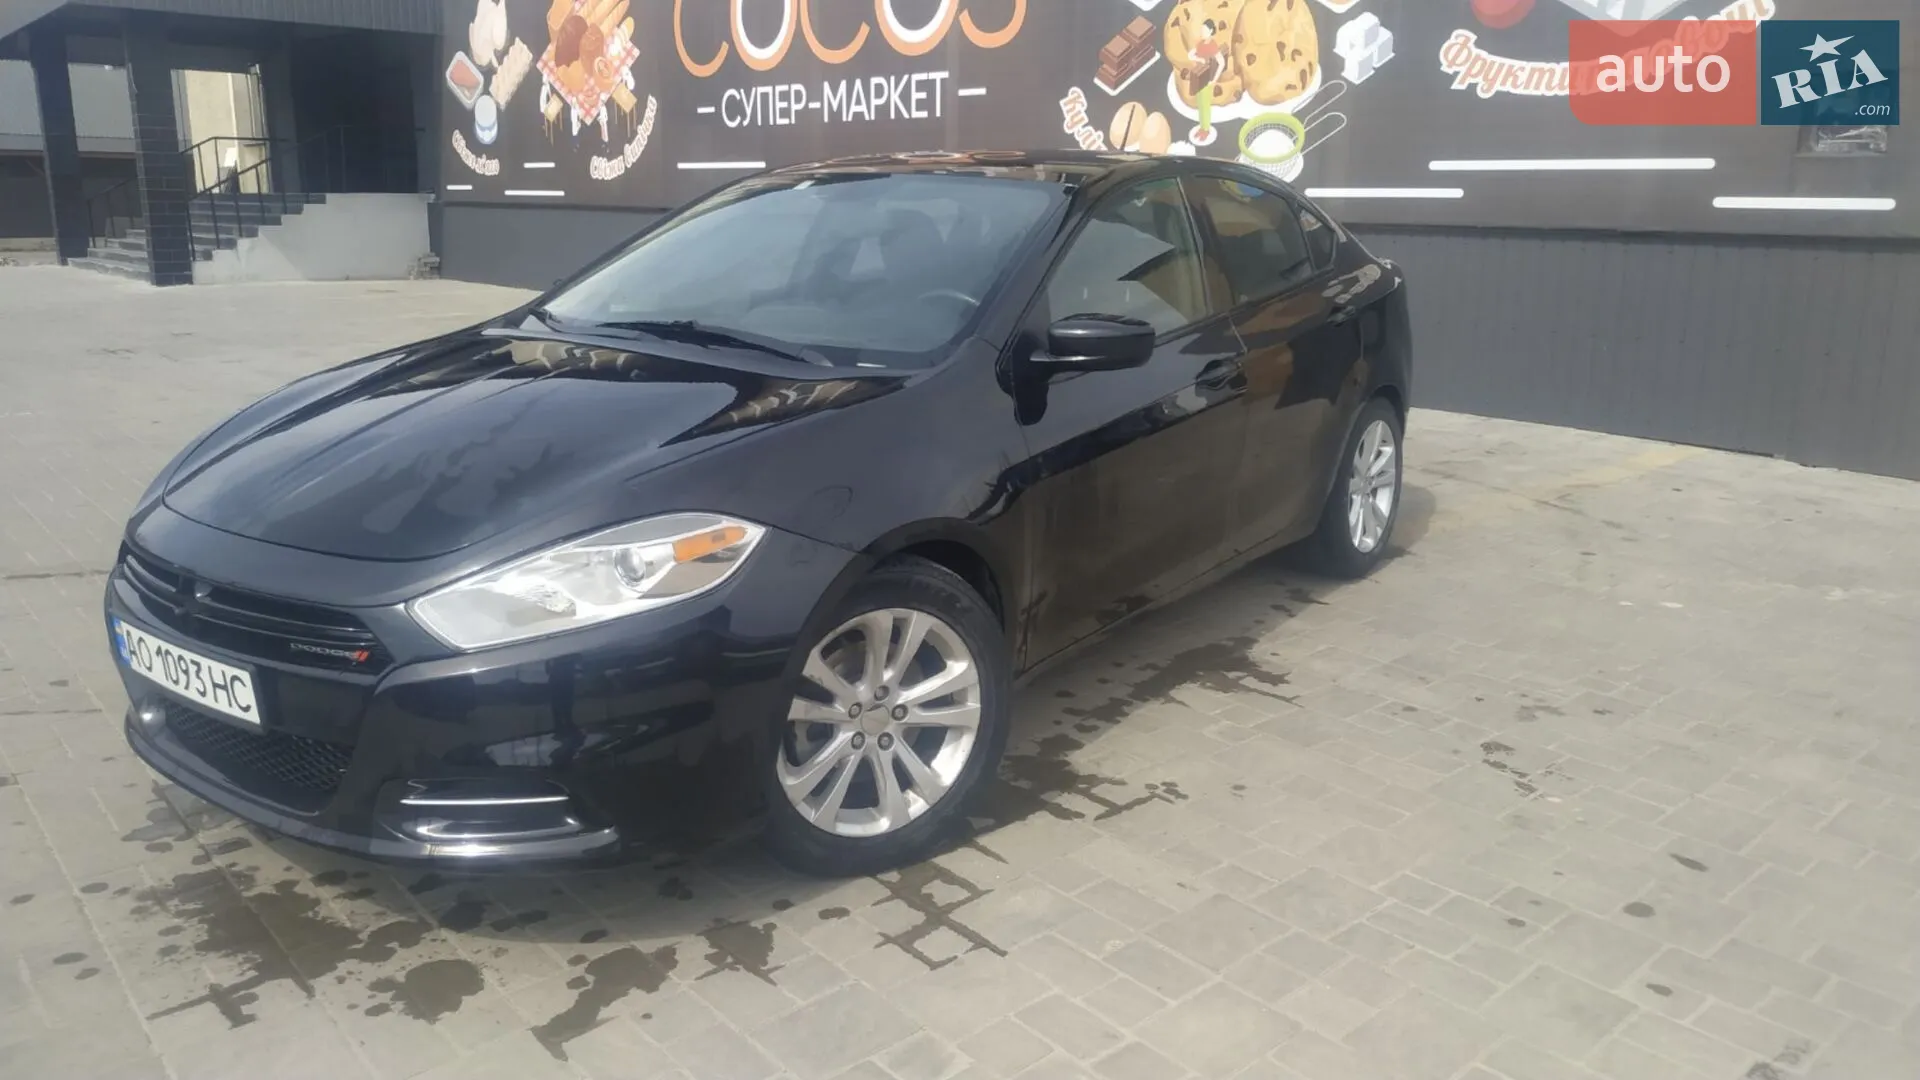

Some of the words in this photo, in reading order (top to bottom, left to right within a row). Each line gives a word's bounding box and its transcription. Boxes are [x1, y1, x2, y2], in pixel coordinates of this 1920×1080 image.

[722, 71, 949, 128] СУПЕР-МАРКЕТ
[126, 630, 152, 673] AO
[155, 644, 207, 698] 1093
[208, 665, 251, 713] HC
